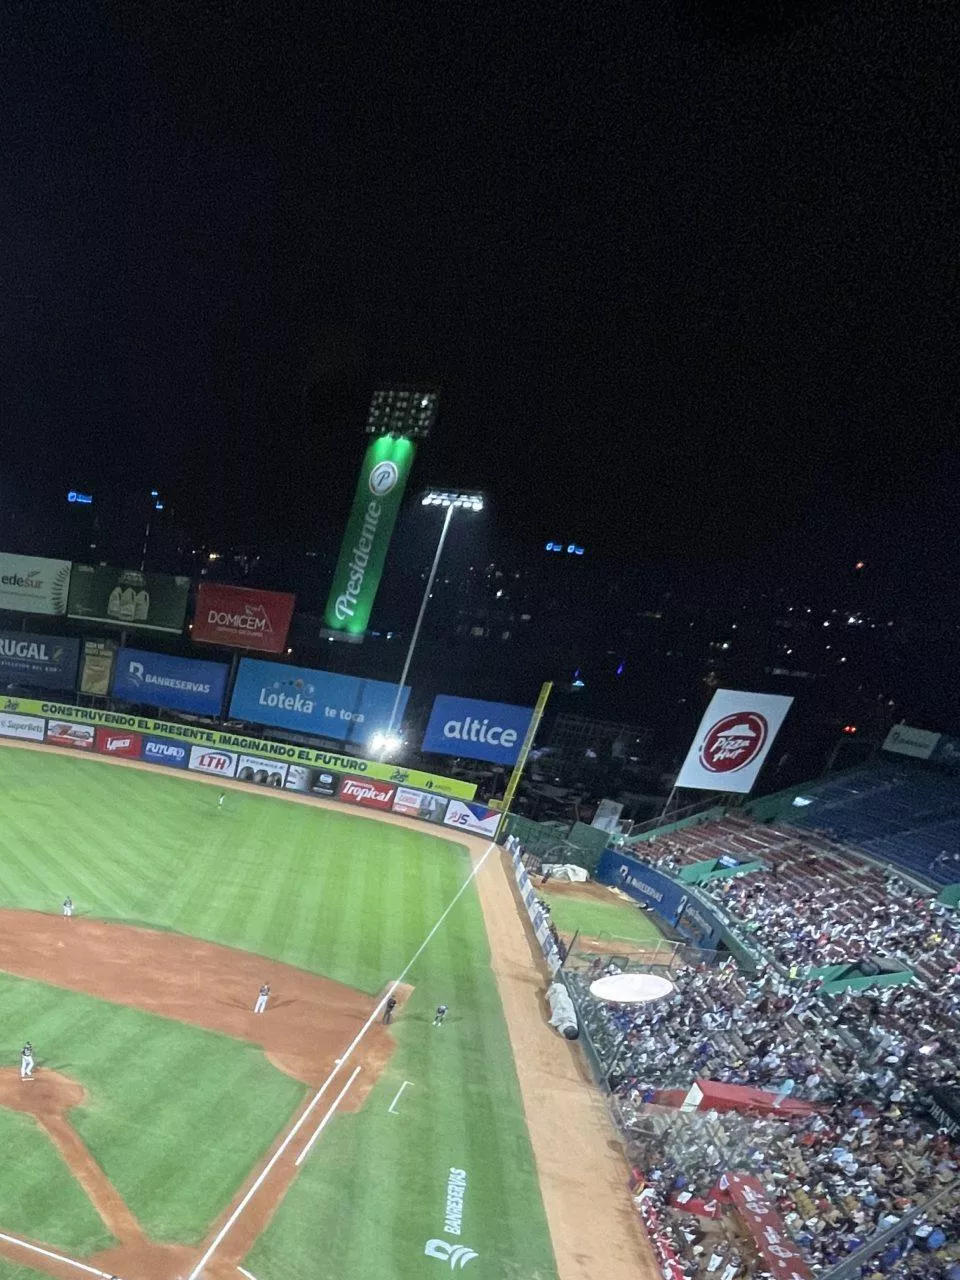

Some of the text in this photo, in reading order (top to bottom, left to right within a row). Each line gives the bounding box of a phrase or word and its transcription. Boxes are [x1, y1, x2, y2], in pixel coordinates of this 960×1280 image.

[334, 501, 383, 620] Presidente
[1, 573, 44, 589] edesur
[208, 610, 267, 630] DOMICEM
[145, 674, 211, 694] BANRESERVAS
[258, 687, 314, 715] Loteka
[339, 709, 365, 724] toca
[41, 703, 136, 727] CONSTRUYENDO
[139, 719, 152, 730] EL
[153, 722, 217, 745] PRESENTE,
[218, 732, 296, 758] IMAGINANDO
[297, 750, 313, 762] EL
[314, 753, 369, 772] FUTURO
[443, 715, 518, 749] altice
[710, 735, 750, 753] Pizza
[714, 748, 745, 762] Hut
[199, 755, 227, 771] LTH
[342, 779, 394, 803] Tropical
[443, 1166, 467, 1236] BANRESERVAS
